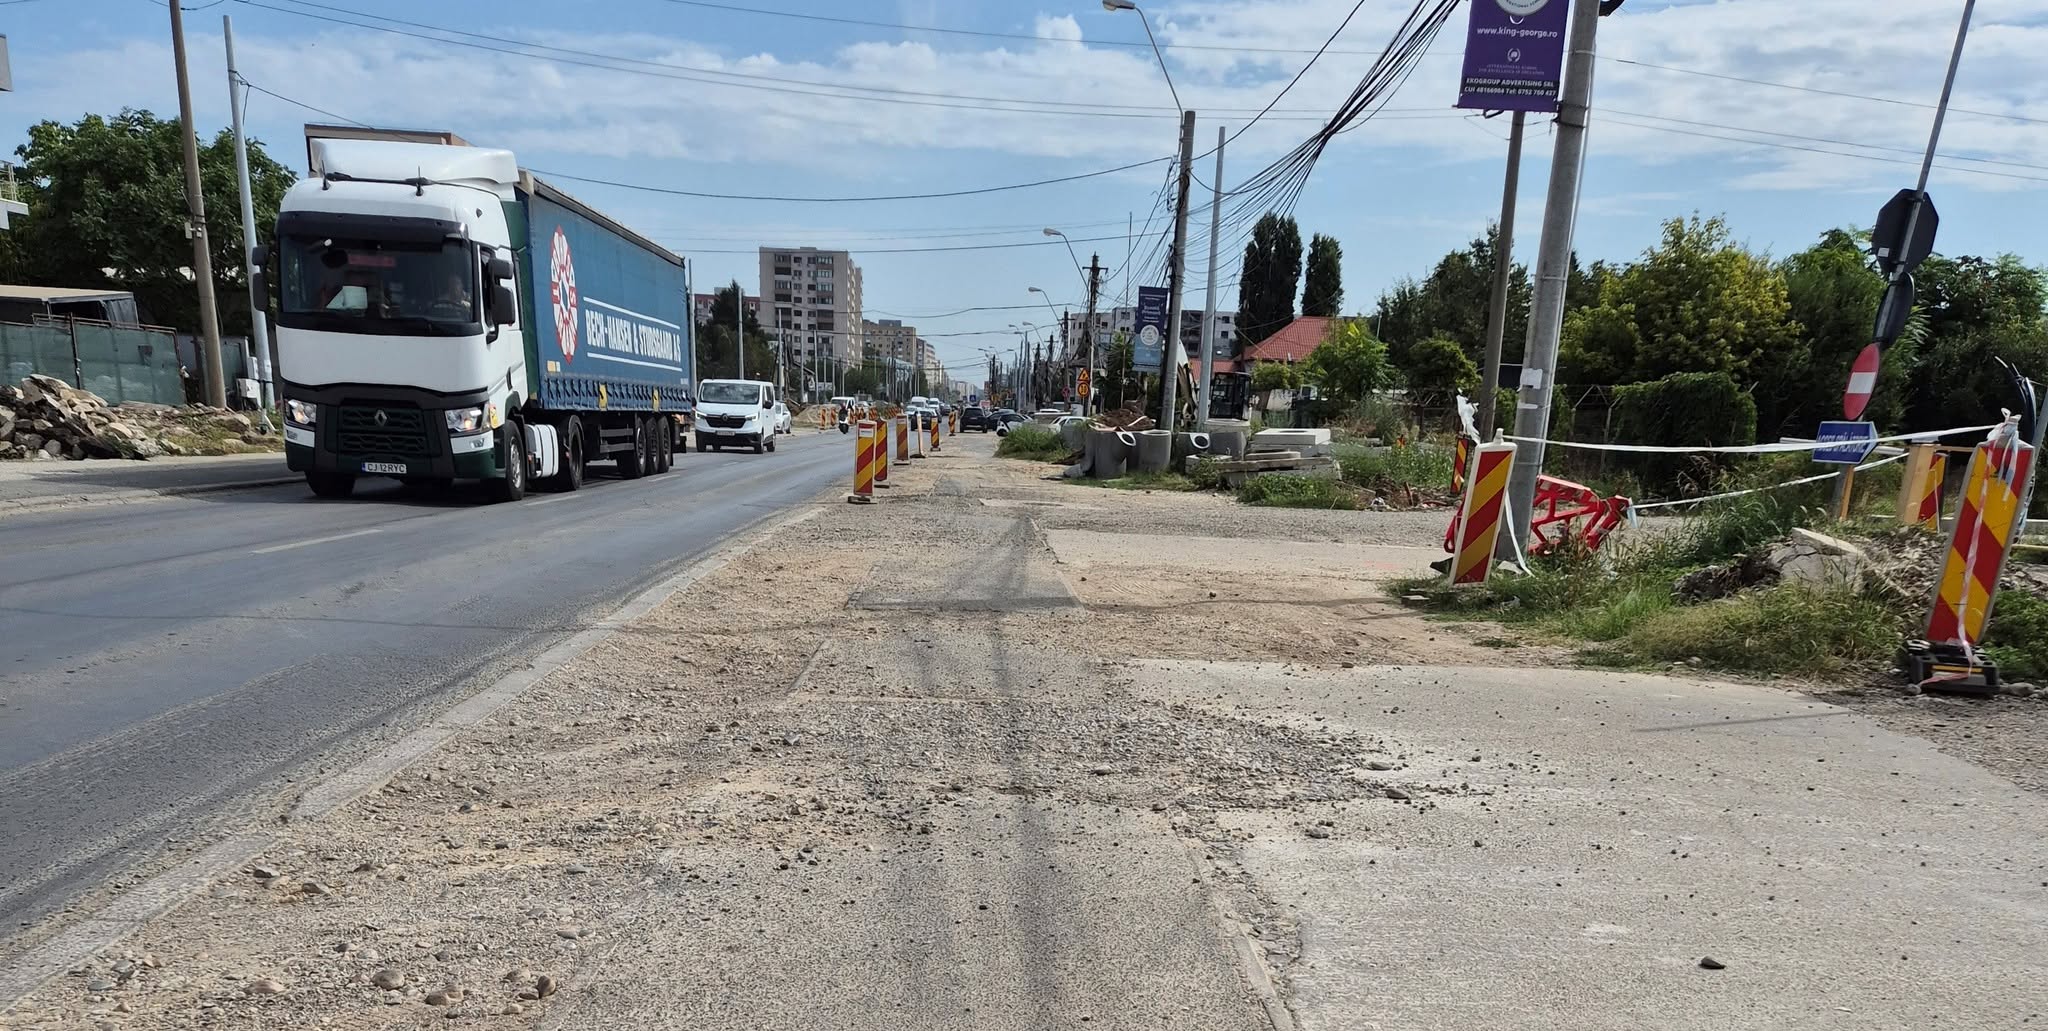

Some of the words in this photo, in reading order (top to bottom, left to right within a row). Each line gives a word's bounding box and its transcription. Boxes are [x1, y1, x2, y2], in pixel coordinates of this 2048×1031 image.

[1477, 26, 1558, 38] www.king-george.ro
[1466, 77, 1500, 85] EKOGROUP
[1501, 79, 1542, 87] ADVERTISING
[367, 463, 378, 472] CJ
